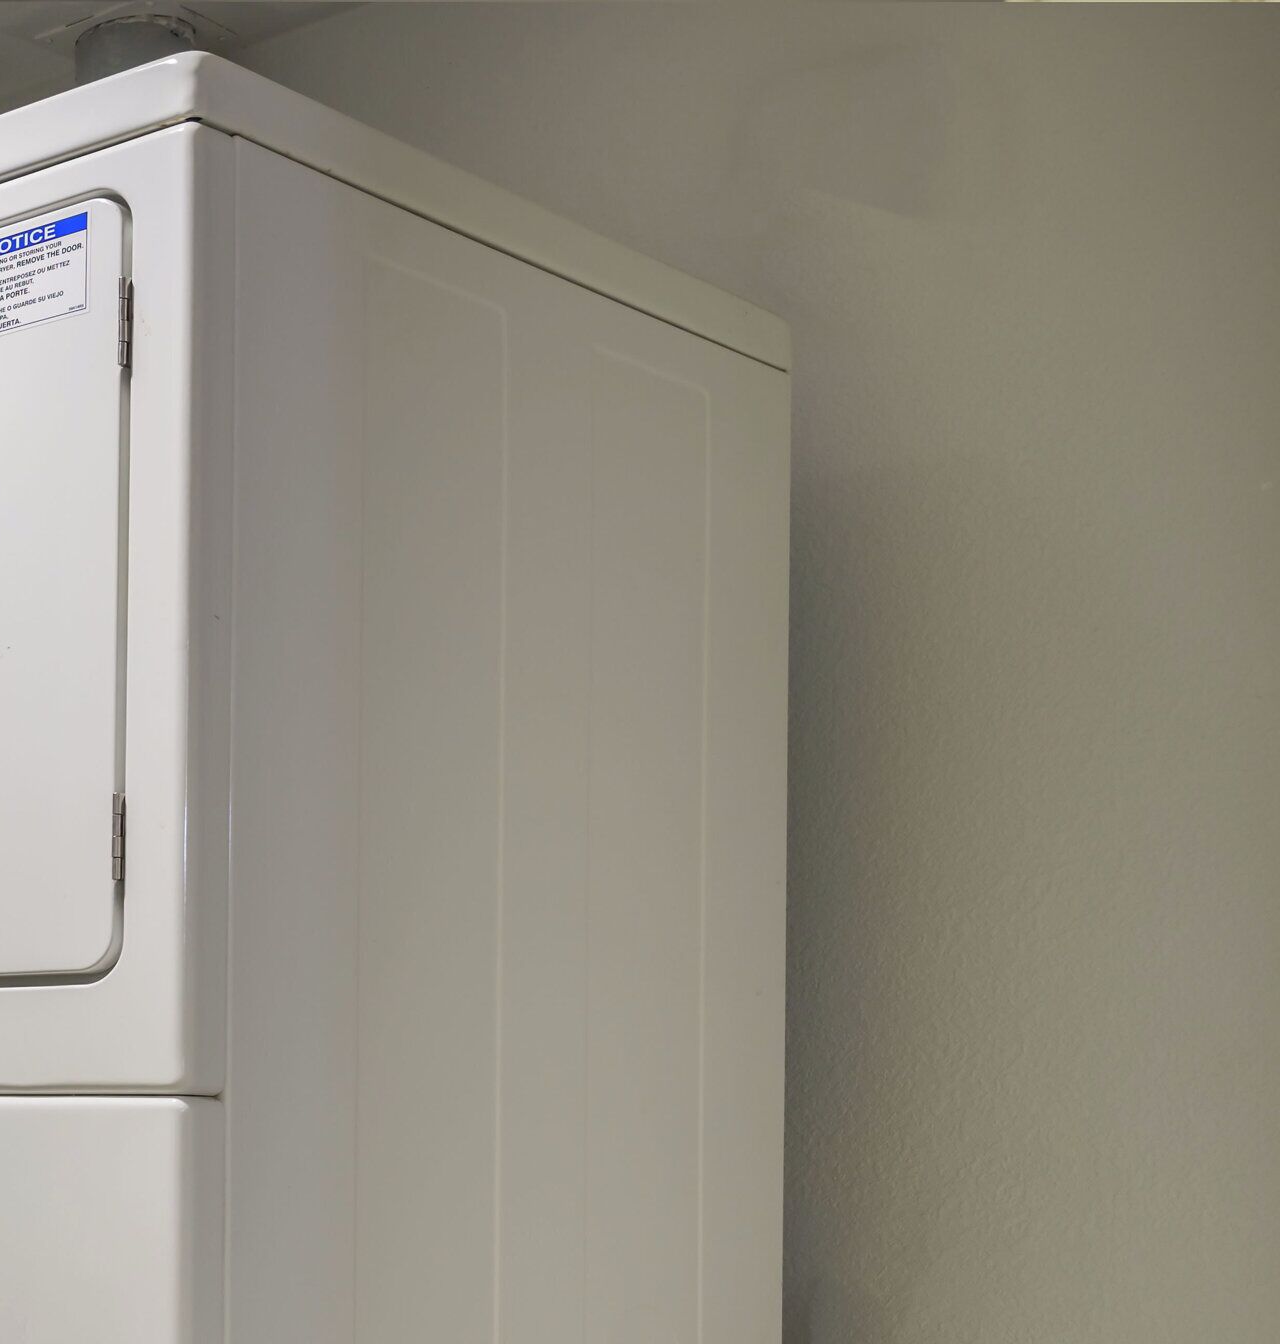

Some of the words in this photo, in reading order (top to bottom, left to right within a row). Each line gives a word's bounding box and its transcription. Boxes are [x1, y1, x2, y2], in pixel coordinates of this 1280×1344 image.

[8, 254, 18, 262] OR
[18, 246, 45, 259] STORING
[45, 241, 62, 251] YOUR
[16, 253, 45, 268] REMOVE
[46, 249, 60, 259] THE
[61, 242, 84, 254] DOOR.
[36, 266, 46, 275] OU
[46, 259, 70, 272] METTEZ
[5, 283, 14, 291] AU
[12, 297, 37, 310] GUARDE
[37, 295, 46, 303] SU
[47, 290, 64, 300] VIEJO
